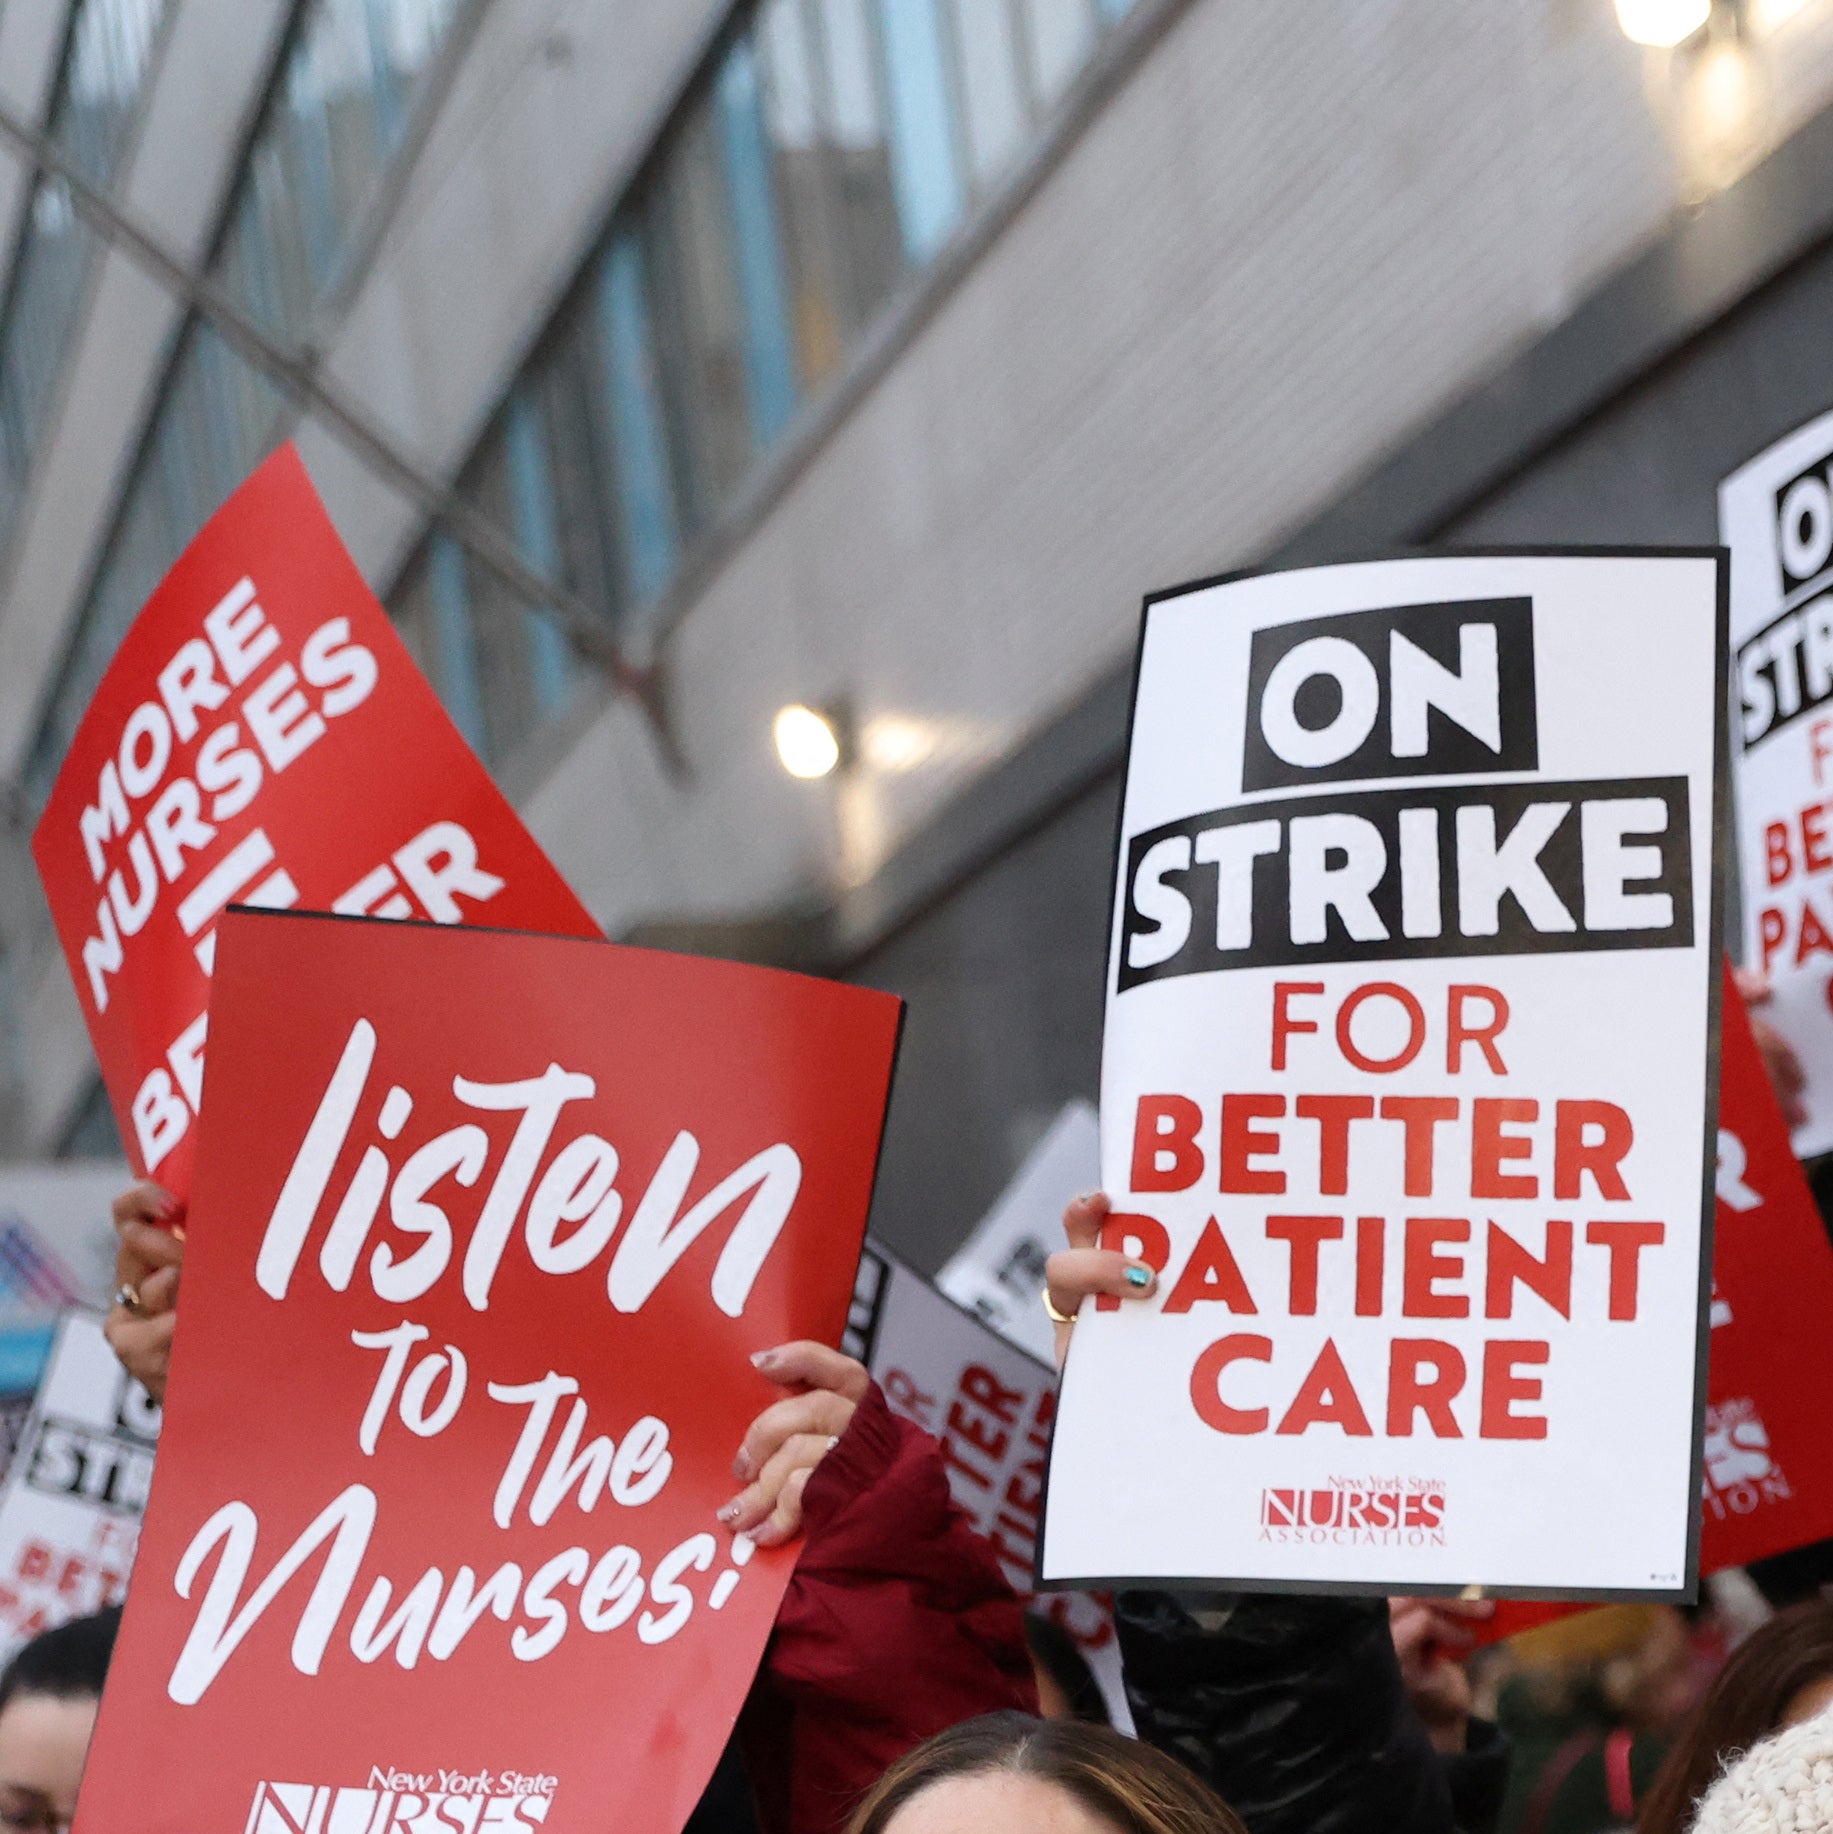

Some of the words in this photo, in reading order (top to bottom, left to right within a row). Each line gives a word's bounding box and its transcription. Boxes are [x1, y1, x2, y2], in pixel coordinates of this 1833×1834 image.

[78, 576, 281, 884] MORE
[1259, 622, 1501, 768] ON
[82, 616, 378, 1013] NURSES
[1127, 797, 1674, 969] STRIKE
[1270, 981, 1511, 1075] FOR
[1129, 1094, 1634, 1201] BETTER
[1095, 1212, 1664, 1322] PATIENT
[1189, 1334, 1550, 1441] CARE
[1259, 1527, 1446, 1547] ASSOCIATION
[1260, 1488, 1446, 1529] NURSES
[1328, 1475, 1363, 1490] New
[1369, 1475, 1403, 1491] York
[1407, 1476, 1447, 1492] State
[367, 1765, 430, 1791] New
[436, 1768, 491, 1793] York
[495, 1770, 558, 1795] State
